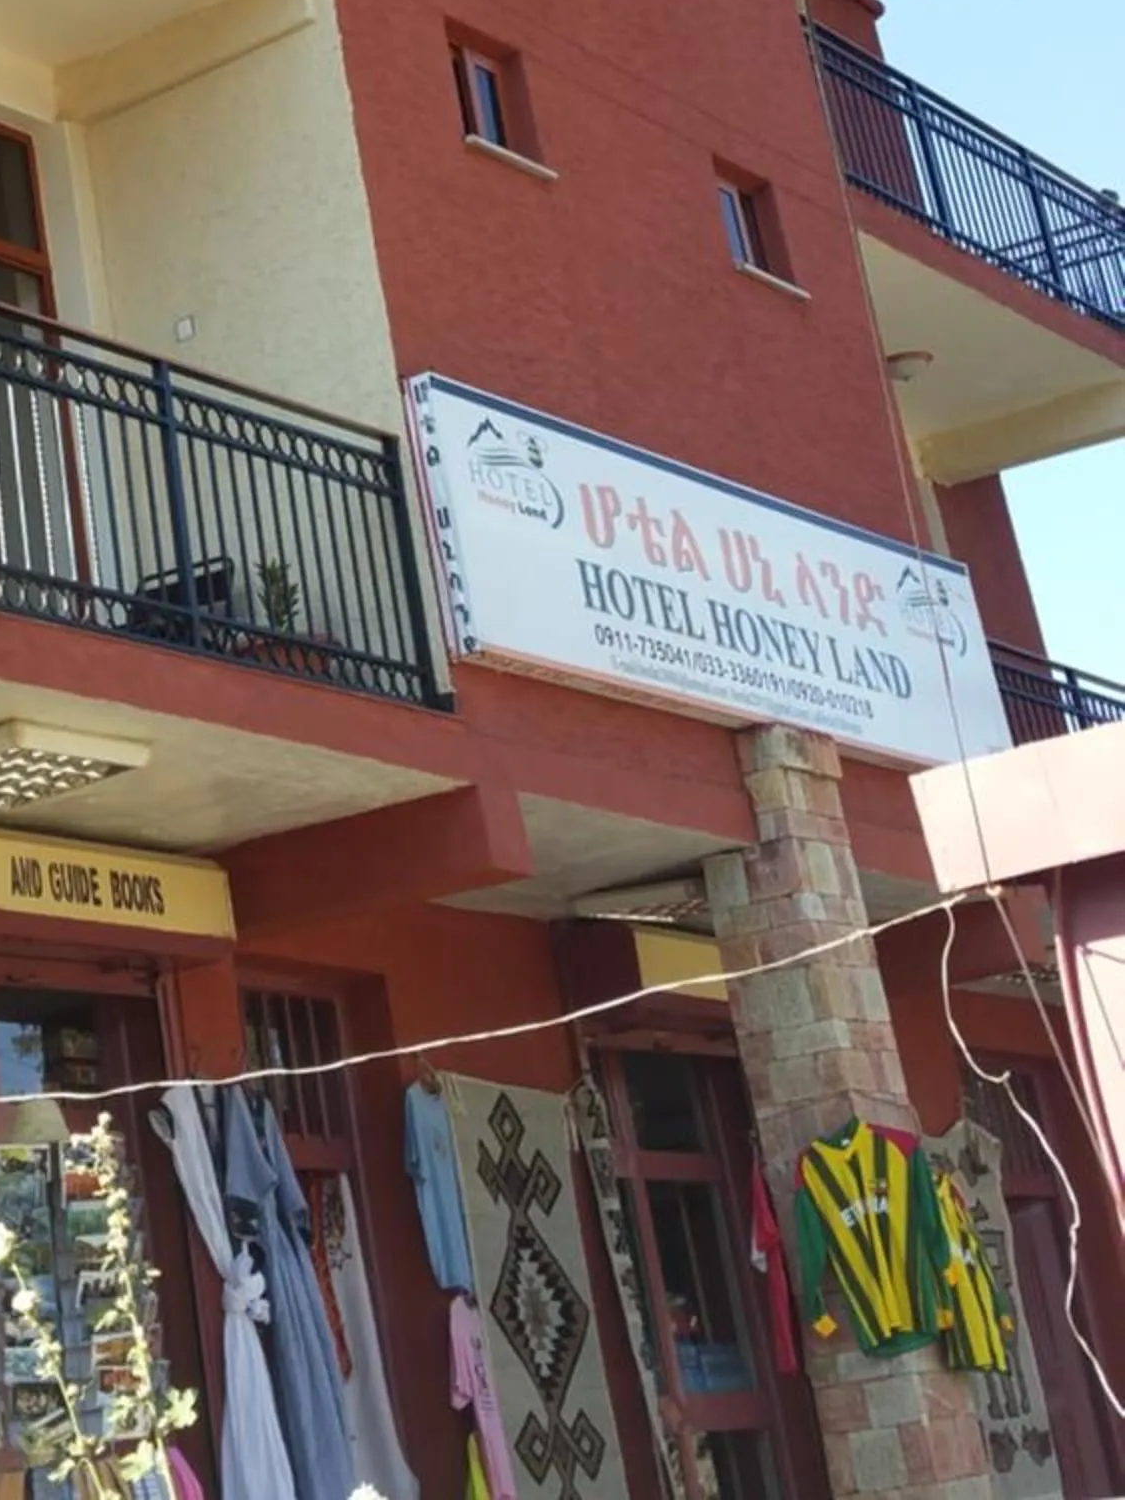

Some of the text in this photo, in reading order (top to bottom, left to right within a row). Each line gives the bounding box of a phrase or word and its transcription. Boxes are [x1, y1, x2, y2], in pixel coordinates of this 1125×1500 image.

[468, 460, 553, 507] HOTEL
[577, 483, 711, 582] ሆቴል
[575, 558, 706, 642] HOTEL
[705, 598, 826, 677] HONEY
[826, 635, 912, 699] LAND
[11, 856, 43, 899] AND
[48, 863, 103, 906] GUIDE
[110, 869, 165, 916] BOOKS
